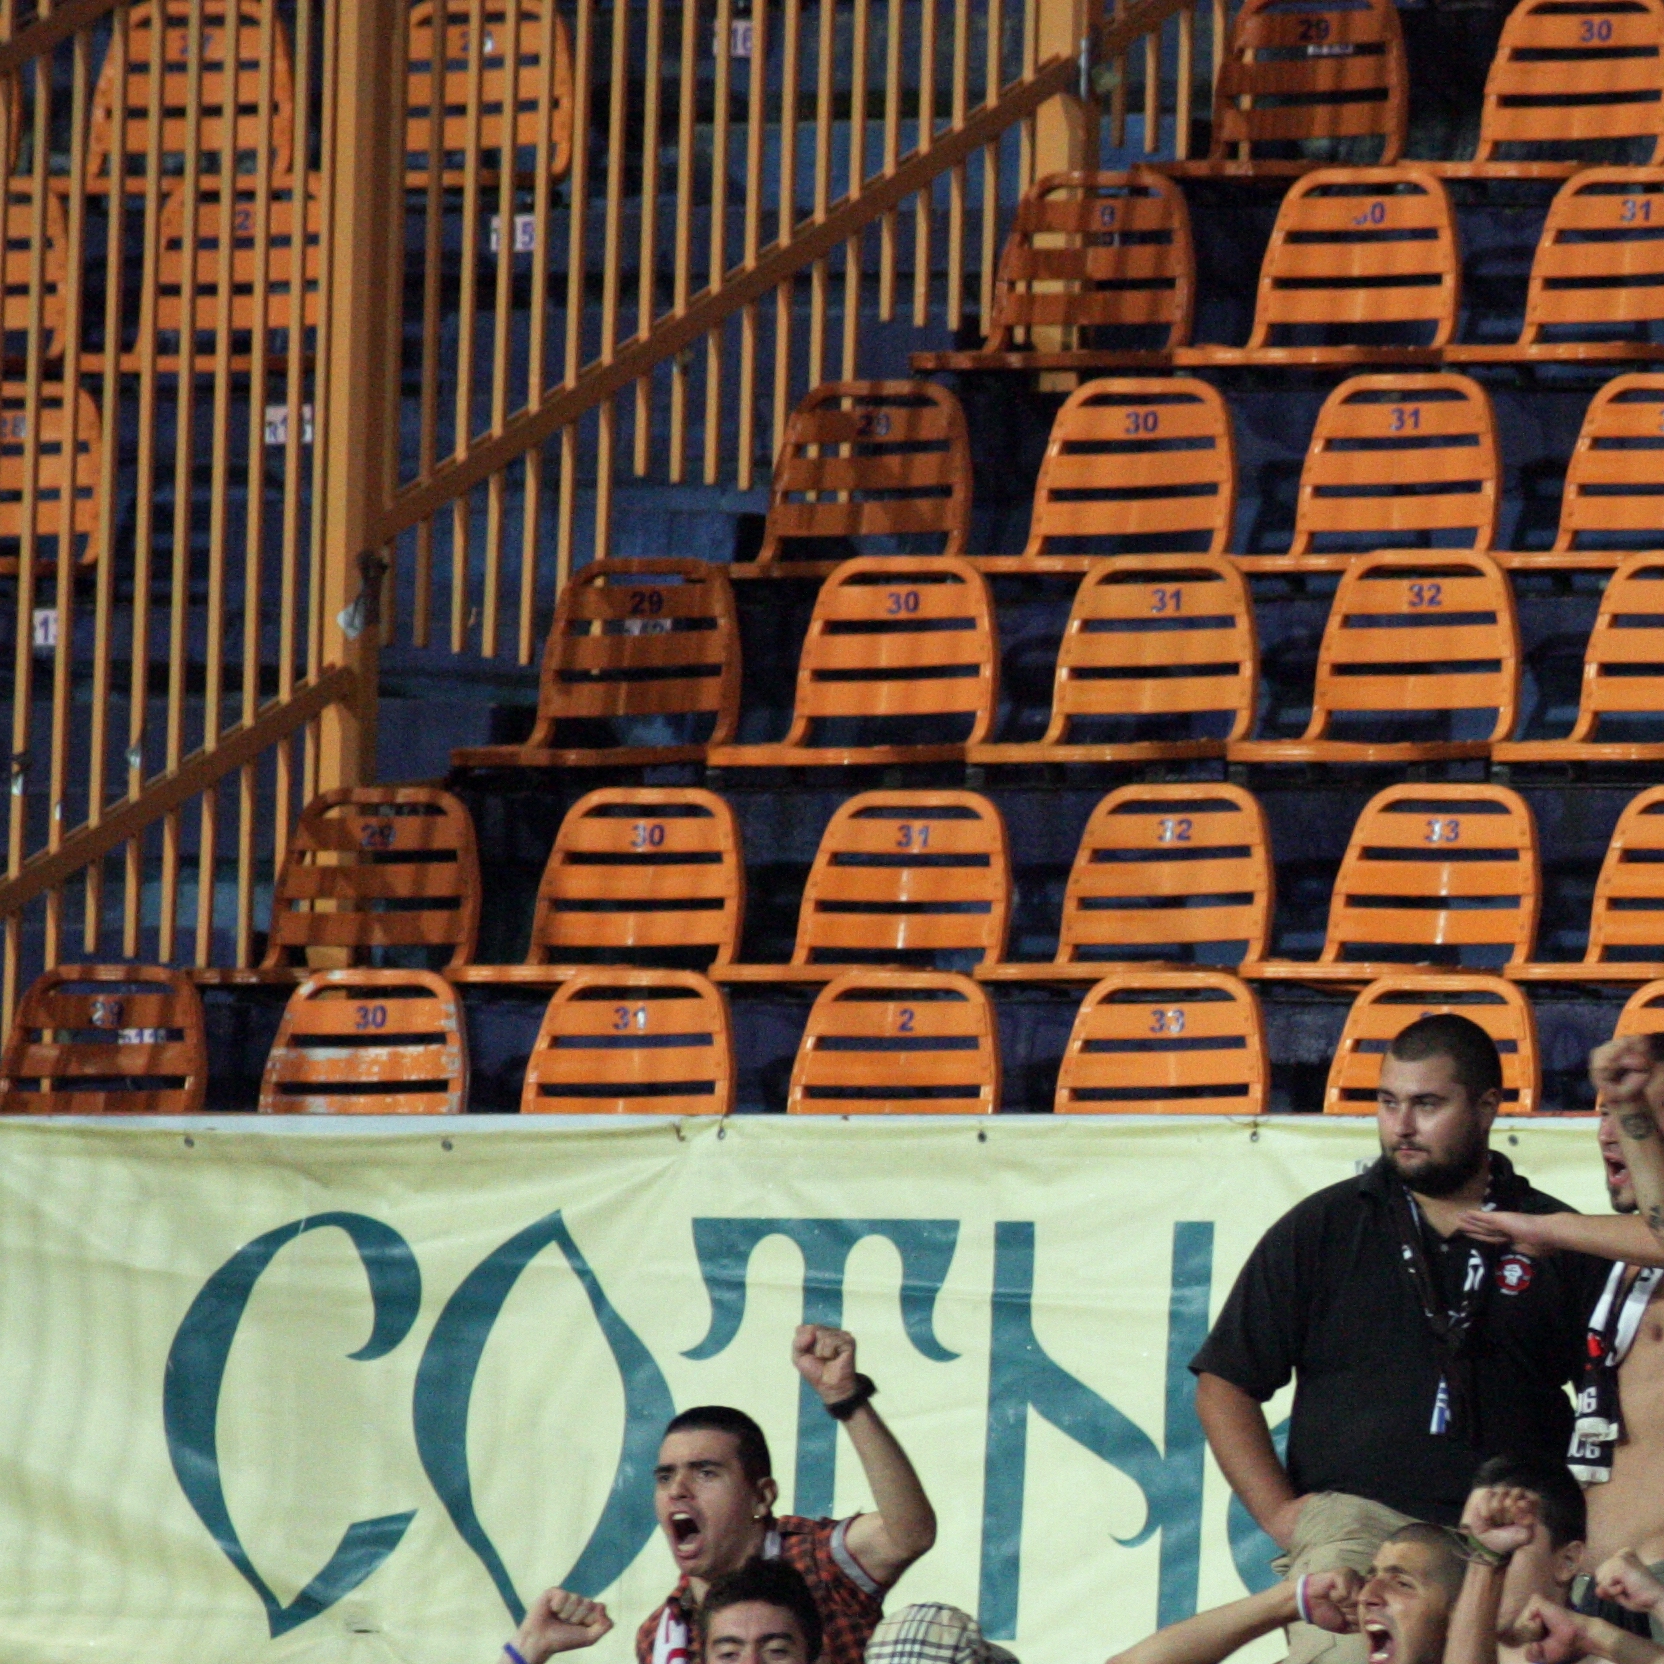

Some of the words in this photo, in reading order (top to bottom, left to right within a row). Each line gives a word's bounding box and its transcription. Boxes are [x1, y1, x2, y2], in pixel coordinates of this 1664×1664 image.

[1583, 21, 1610, 42] 30
[1622, 200, 1651, 222] 31
[1127, 413, 1155, 434] 30
[1390, 409, 1420, 431] 31
[889, 592, 917, 615] 30
[1151, 590, 1181, 613] 31
[1410, 585, 1440, 607] 32
[633, 825, 662, 848] 30
[898, 826, 929, 848] 31
[355, 1006, 386, 1030] 30
[614, 1007, 647, 1030] 31
